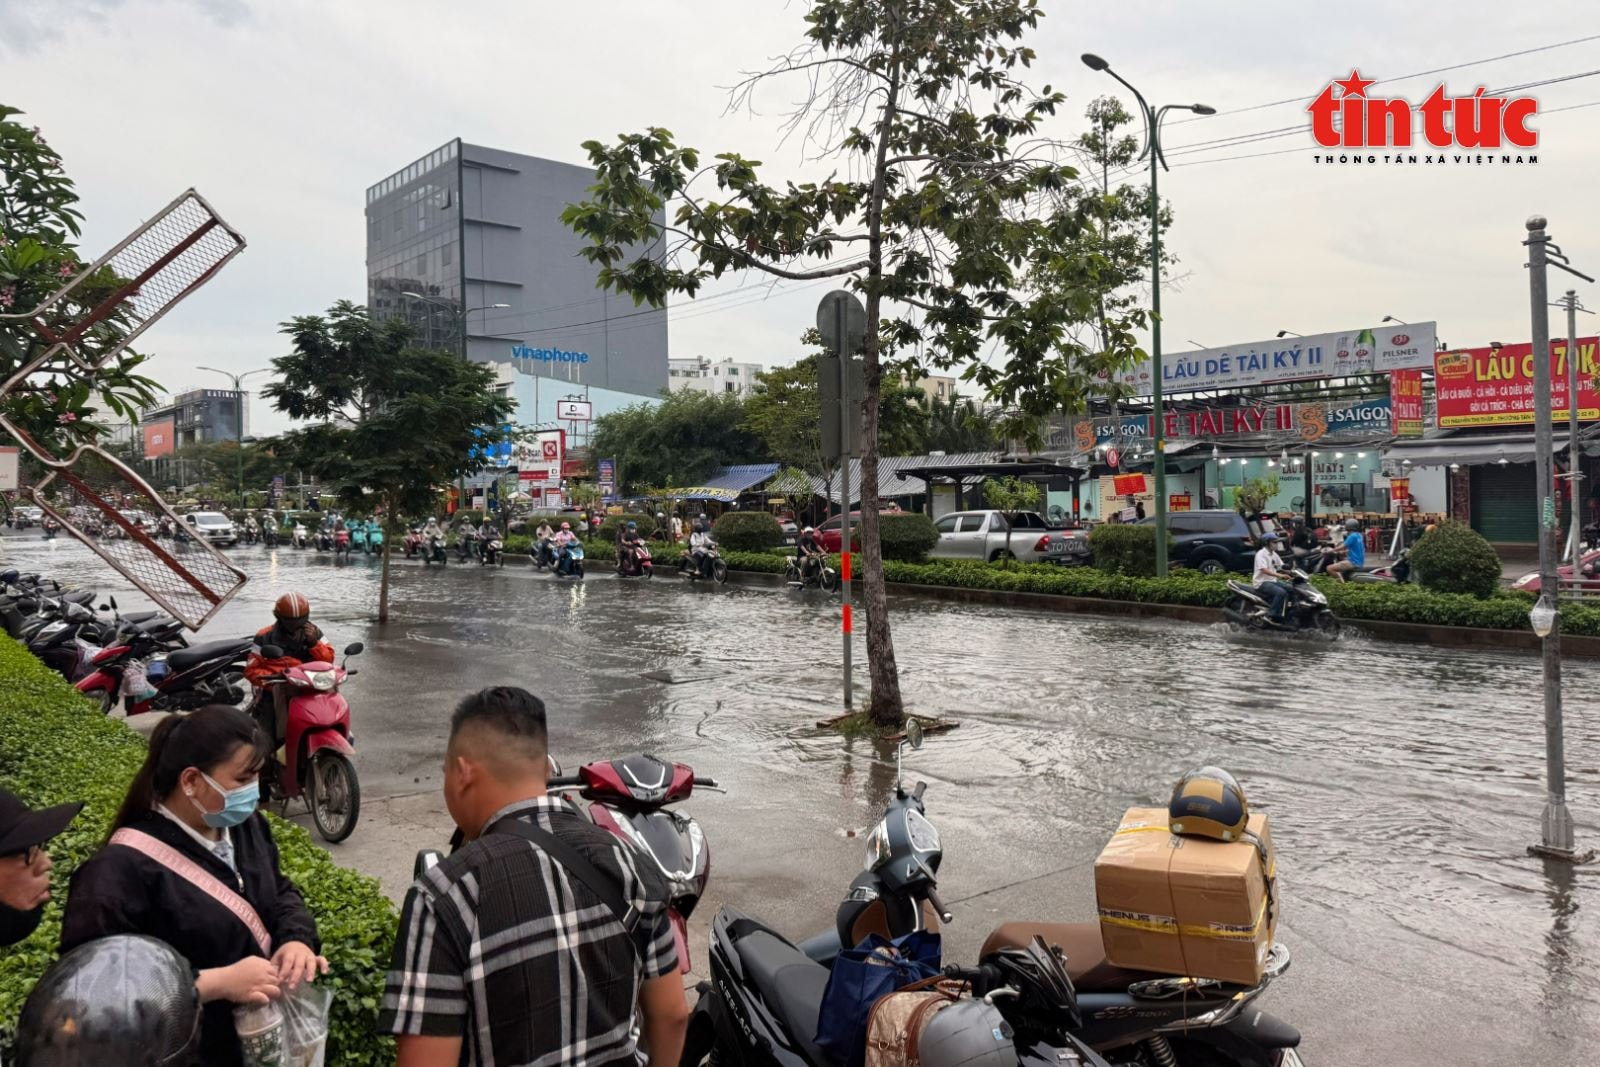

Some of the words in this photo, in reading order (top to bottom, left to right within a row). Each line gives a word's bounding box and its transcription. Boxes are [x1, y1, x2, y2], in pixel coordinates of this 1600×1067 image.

[511, 344, 588, 364] vinaphone
[1205, 353, 1230, 375] DÊ
[1236, 349, 1267, 371] TÀI
[1274, 344, 1302, 368] KÝ
[1382, 348, 1418, 358] PILSNER
[1186, 406, 1225, 436] TÀI
[1232, 400, 1268, 434] KÝ
[1102, 424, 1145, 436] SAGON
[1051, 541, 1086, 552] TOYOTA
